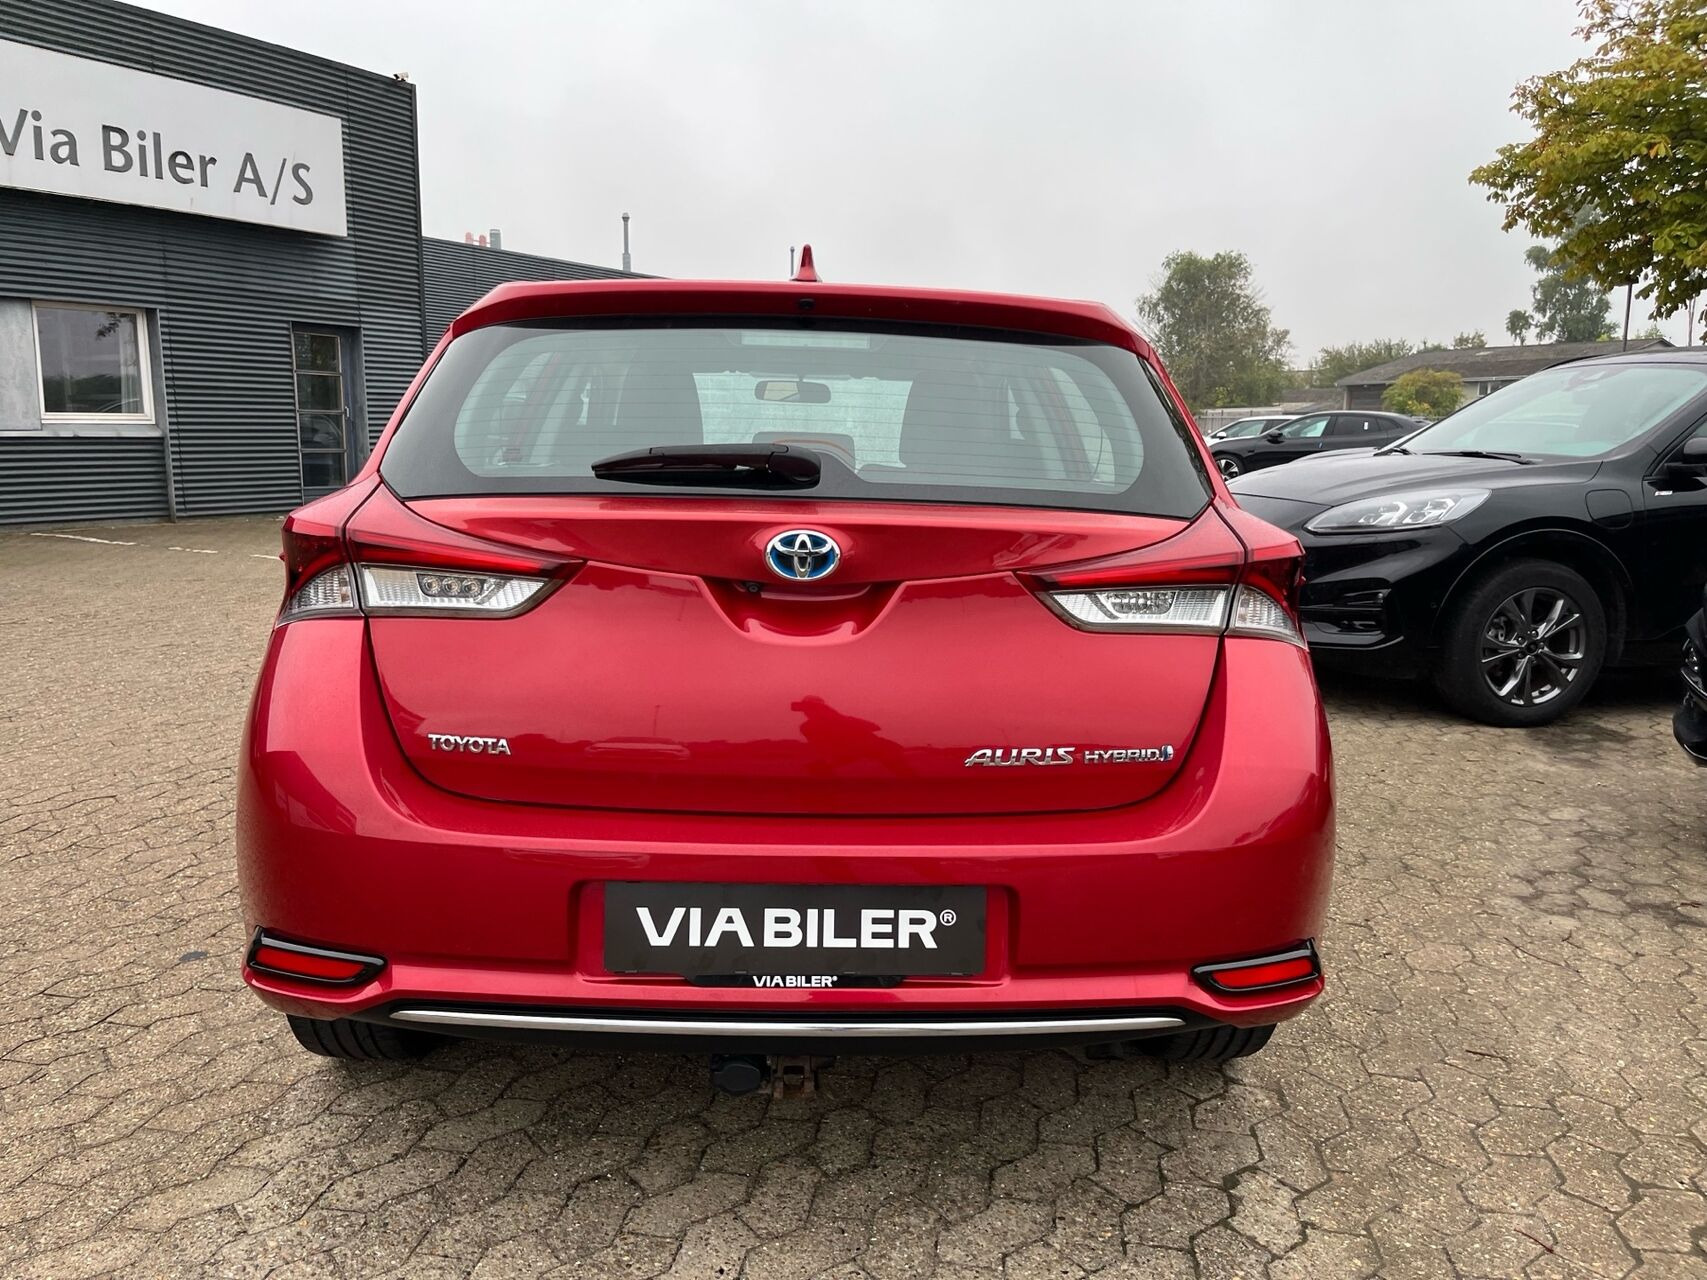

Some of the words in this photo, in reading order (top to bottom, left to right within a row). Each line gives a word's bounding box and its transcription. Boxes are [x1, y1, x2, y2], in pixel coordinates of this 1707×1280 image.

[0, 108, 80, 167] Via
[101, 124, 217, 188] Biler
[233, 152, 313, 206] A/S
[427, 733, 511, 755] TOYOTA
[964, 747, 1075, 767] AURIS
[1084, 749, 1160, 764] HYBRID
[635, 907, 755, 947] VIA
[752, 975, 785, 988] VIA
